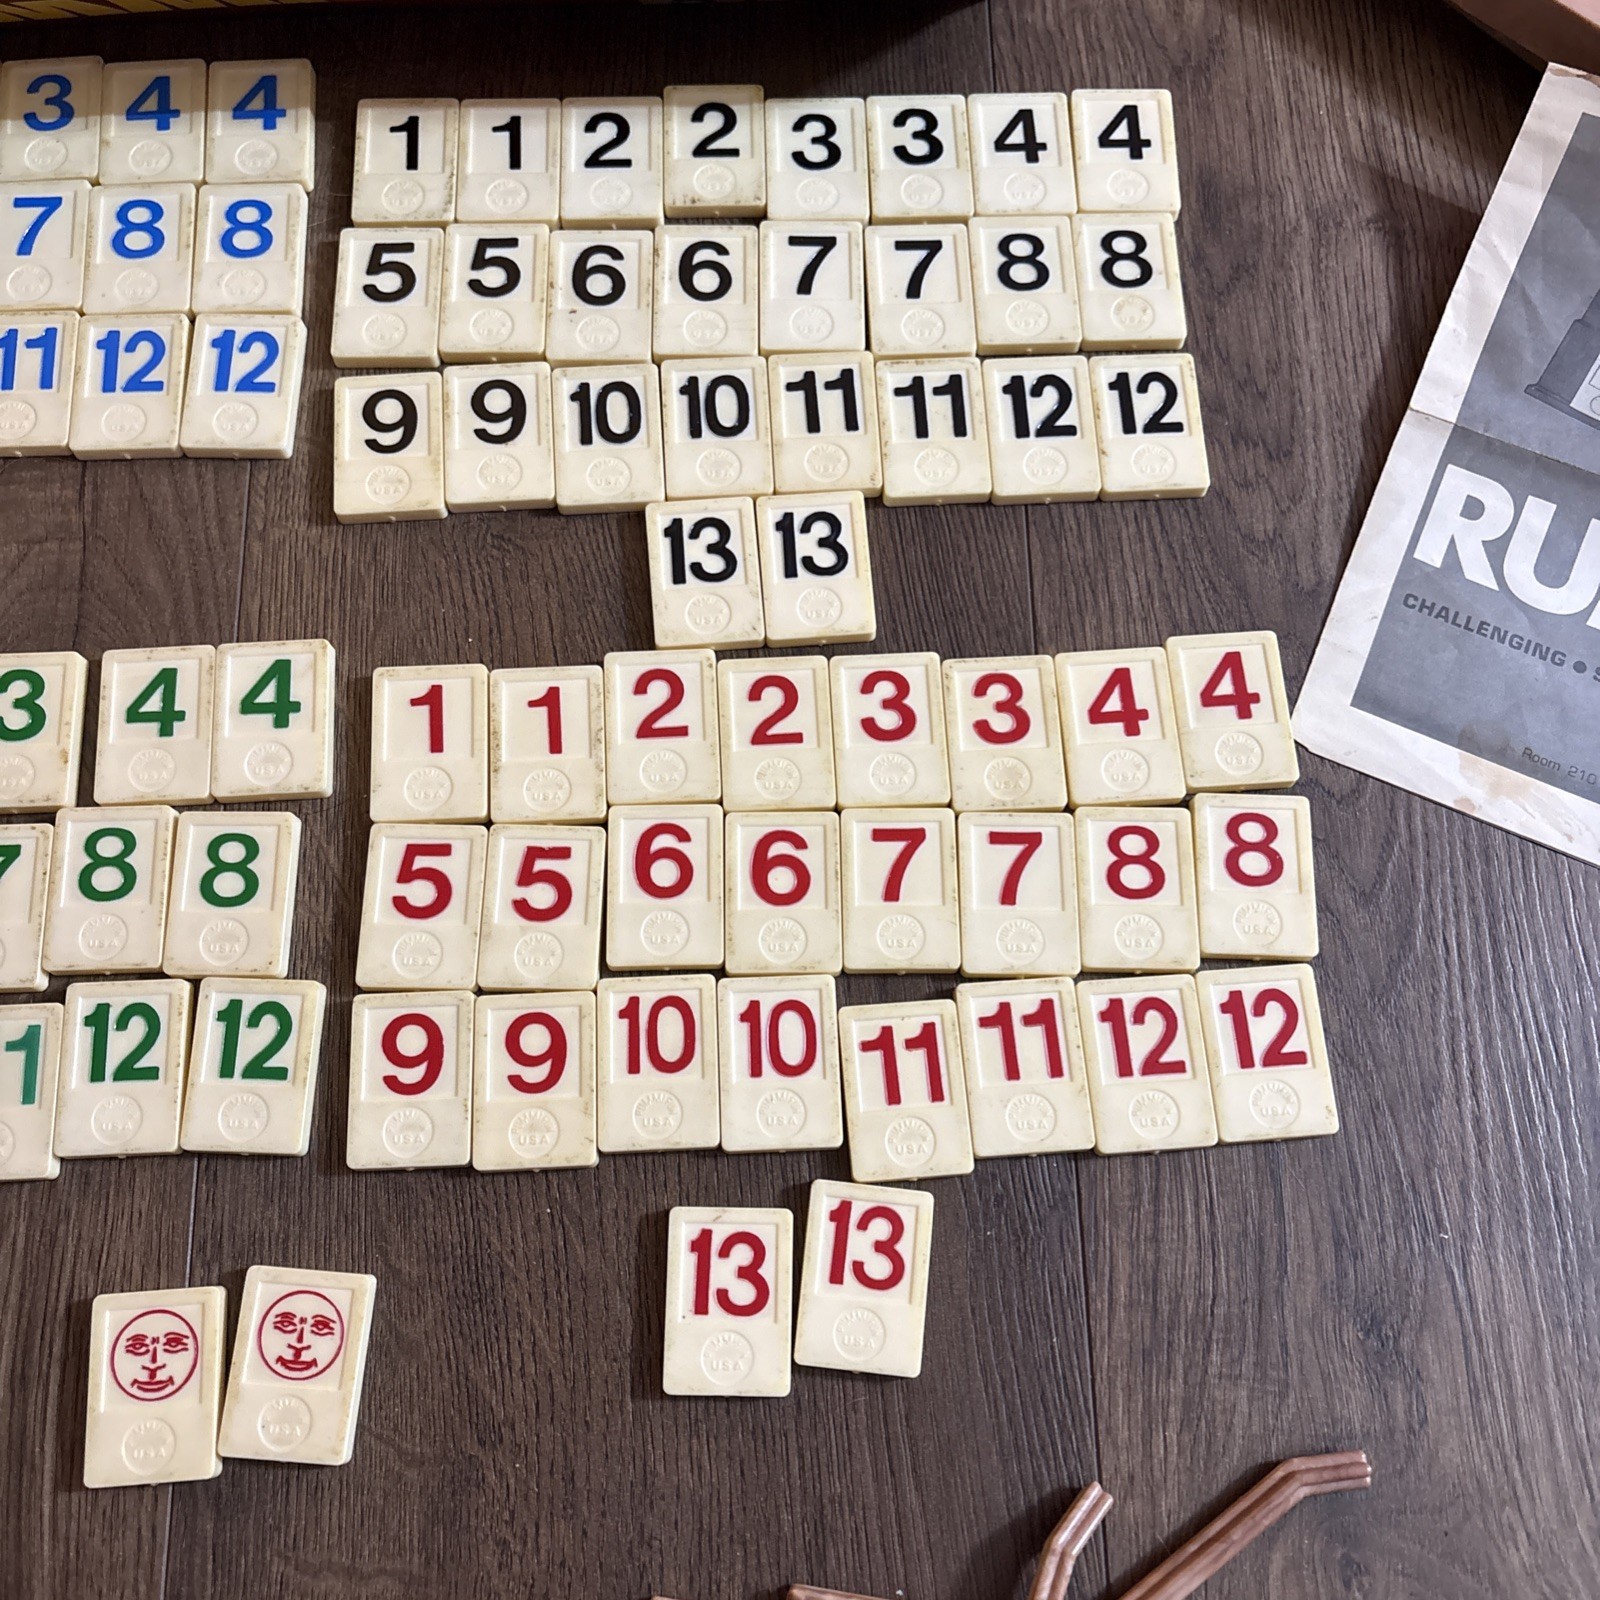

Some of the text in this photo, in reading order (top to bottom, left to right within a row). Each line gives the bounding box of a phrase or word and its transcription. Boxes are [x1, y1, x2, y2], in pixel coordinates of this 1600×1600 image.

[23, 73, 76, 132] 3
[125, 75, 181, 131] 4
[232, 74, 286, 131] 4
[691, 101, 740, 158] 2
[893, 108, 944, 165] 3
[994, 109, 1047, 163] 4
[1098, 104, 1152, 160] 4
[389, 115, 420, 171] 1
[491, 115, 522, 170] 1
[584, 112, 632, 168] 2
[791, 113, 842, 170] 3
[13, 196, 63, 256] 7
[111, 199, 165, 259] 8
[220, 199, 273, 259] 8
[1100, 230, 1153, 288] 8
[362, 242, 416, 303] 5
[467, 237, 521, 298] 5
[571, 244, 626, 306] 6
[678, 240, 732, 302] 6
[788, 235, 837, 295] 7
[894, 240, 943, 299] 7
[997, 233, 1050, 291] 8
[0, 327, 58, 391] 11
[96, 330, 166, 393] 12
[211, 329, 279, 393] 12
[362, 389, 418, 454] 9
[470, 379, 527, 445] 9
[569, 381, 642, 446] 10
[679, 374, 750, 439] 10
[785, 368, 859, 434] 11
[893, 374, 967, 439] 11
[1002, 374, 1077, 439] 12
[1108, 371, 1184, 435] 12
[663, 517, 738, 585] 13
[775, 511, 849, 579] 13
[1403, 593, 1567, 667] CHALLENGING
[0, 669, 46, 741] 3
[126, 668, 185, 737] 4
[240, 659, 301, 728] 4
[410, 684, 444, 753] 1
[633, 668, 689, 739] 2
[748, 675, 804, 746] 2
[860, 670, 916, 742] 3
[973, 673, 1031, 744] 3
[1088, 667, 1149, 737] 4
[1200, 651, 1260, 720] 4
[527, 686, 563, 754] 1
[1522, 747, 1597, 785] Room 210
[78, 828, 137, 902] 8
[200, 833, 259, 907] 8
[392, 843, 452, 920] 5
[512, 845, 573, 922] 5
[634, 822, 694, 899] 6
[751, 830, 811, 906] 6
[872, 827, 926, 902] 7
[988, 831, 1042, 906] 7
[1106, 825, 1166, 900] 8
[1225, 812, 1284, 887] 8
[84, 1002, 161, 1082] 12
[216, 999, 292, 1080] 12
[381, 1013, 445, 1096] 9
[504, 1011, 567, 1094] 9
[618, 995, 696, 1075] 10
[739, 999, 817, 1078] 10
[978, 998, 1064, 1081] 11
[1099, 997, 1186, 1078] 12
[1220, 988, 1307, 1069] 12
[860, 1022, 945, 1106] 11
[690, 1228, 770, 1317] 13
[829, 1200, 905, 1291] 13
